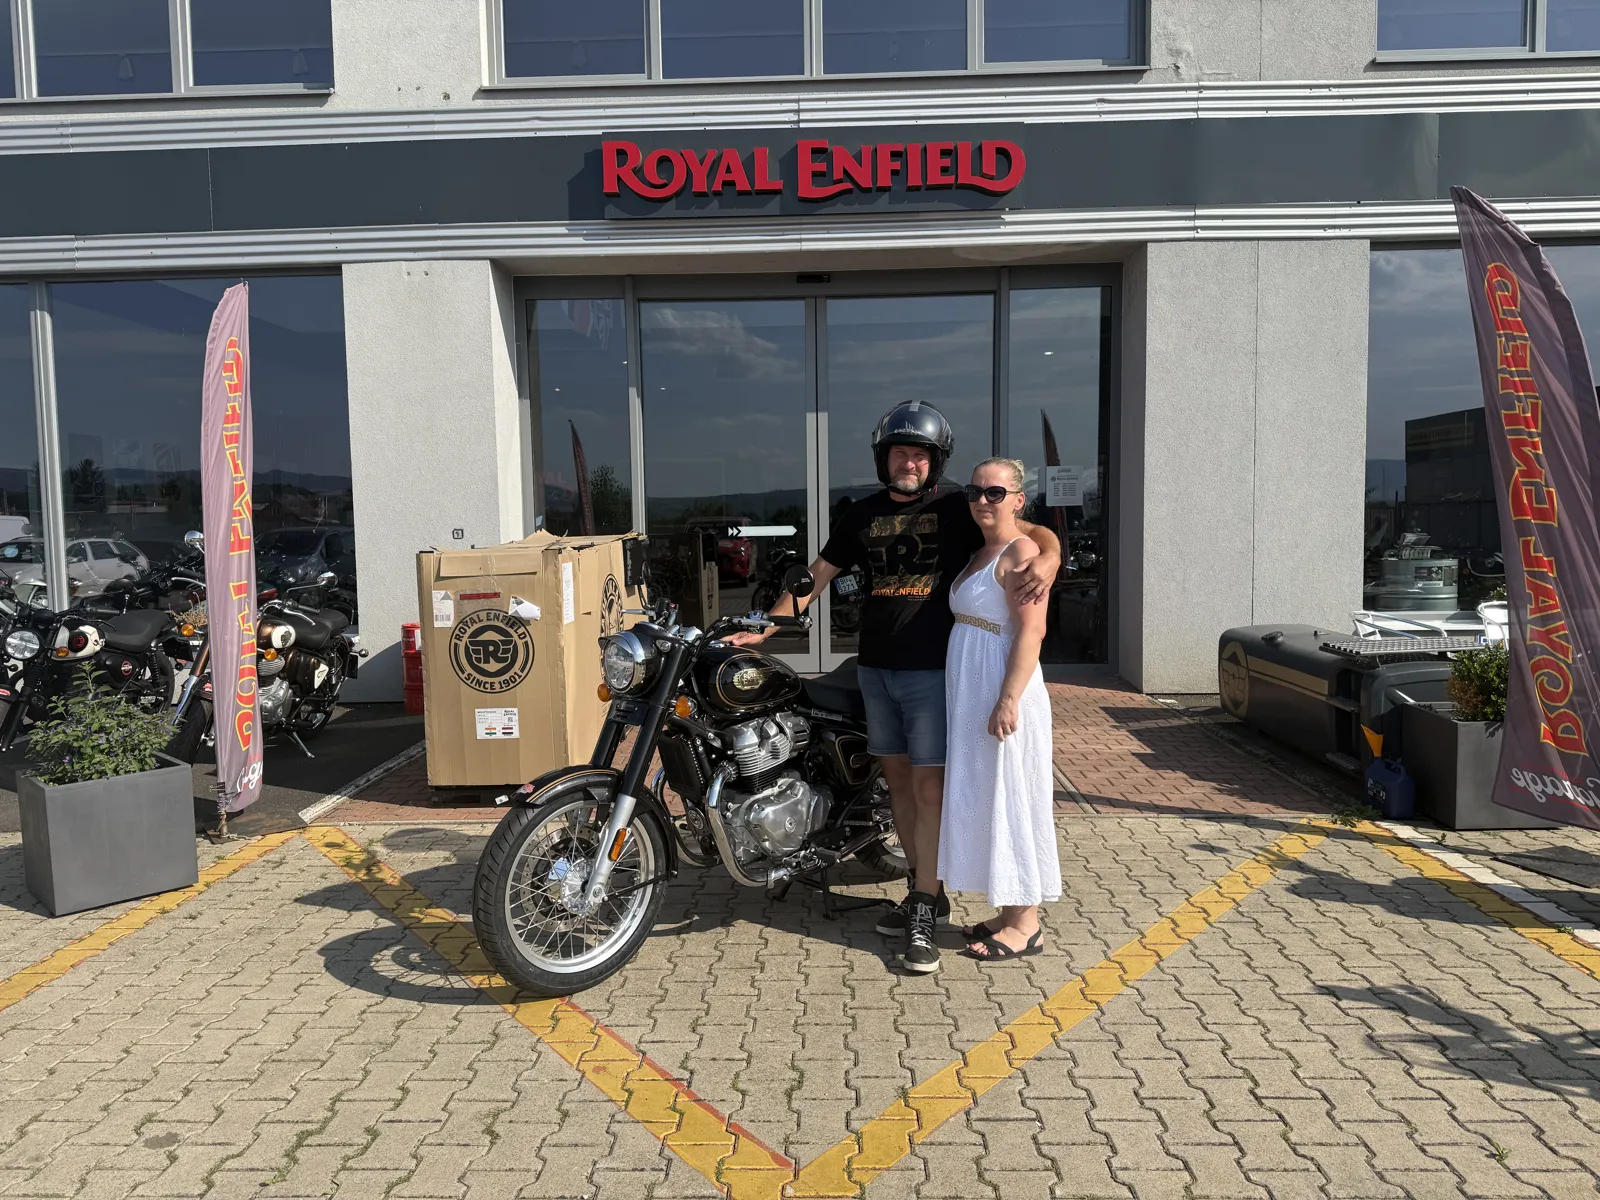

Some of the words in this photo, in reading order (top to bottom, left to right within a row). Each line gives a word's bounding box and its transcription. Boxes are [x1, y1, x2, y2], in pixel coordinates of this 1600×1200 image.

[601, 140, 784, 199] ROYAL
[796, 138, 1027, 199] ENFIELD
[454, 613, 484, 642] ROYAL
[486, 612, 528, 641] ENFIELD
[464, 672, 496, 690] SINCE
[498, 671, 523, 690] 1901
